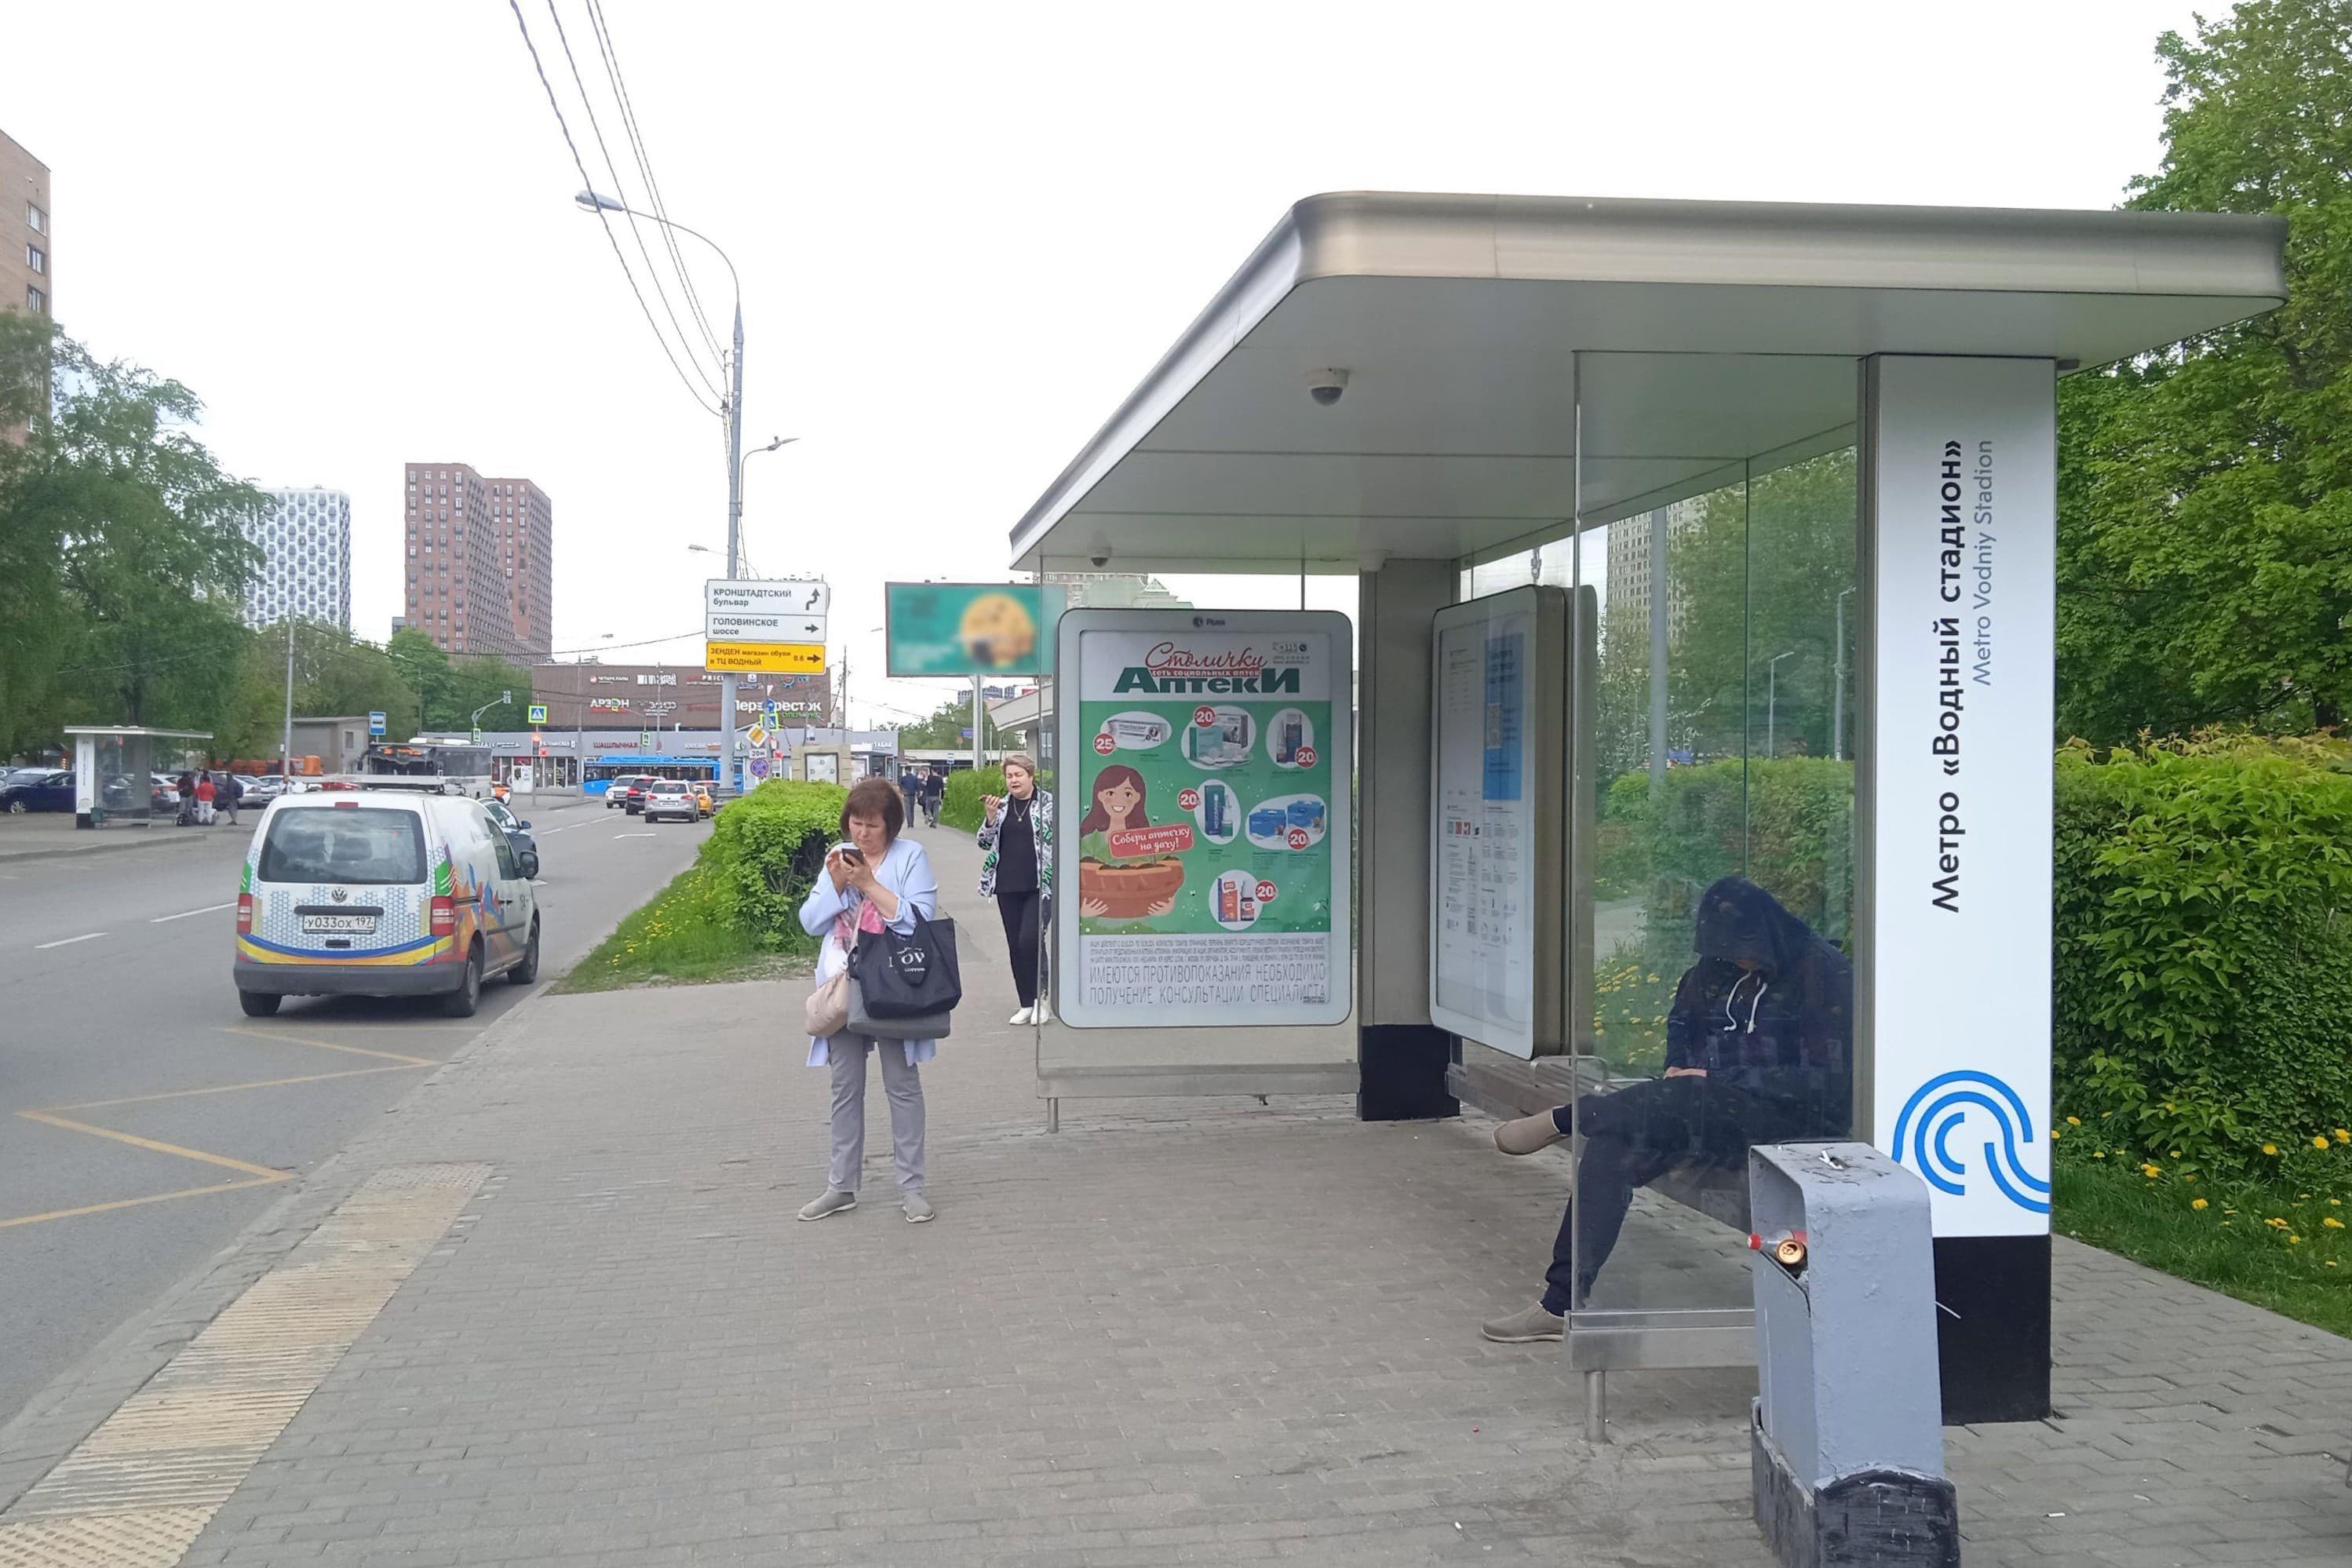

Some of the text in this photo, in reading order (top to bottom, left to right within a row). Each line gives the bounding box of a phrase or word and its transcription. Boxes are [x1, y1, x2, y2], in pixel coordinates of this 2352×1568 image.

[1972, 440, 1996, 686] Metro Vodniy Stadion
[713, 589, 791, 598] КРОНШТАДТСКИЙ
[713, 597, 749, 607] бульвар
[713, 618, 779, 626] ГОЛОВИНСКОЕ
[710, 647, 740, 656] ЗЕНДЕН
[1145, 642, 1268, 667] Столички
[1932, 440, 1965, 913] Метро «Водный стадион»
[1112, 827, 1190, 845] Собери аптечку
[1154, 837, 1179, 853] дачу!
[1090, 963, 1326, 983] ИМЕЮТСЯ ПРОТИВОПОКАЗАНИЯ НЕОБХОДИМО
[1090, 983, 1326, 1005] ПОЛУЧЕНИЕ КОНСУЛЬТАЦИИ СПЕЦИАЛИСТА
